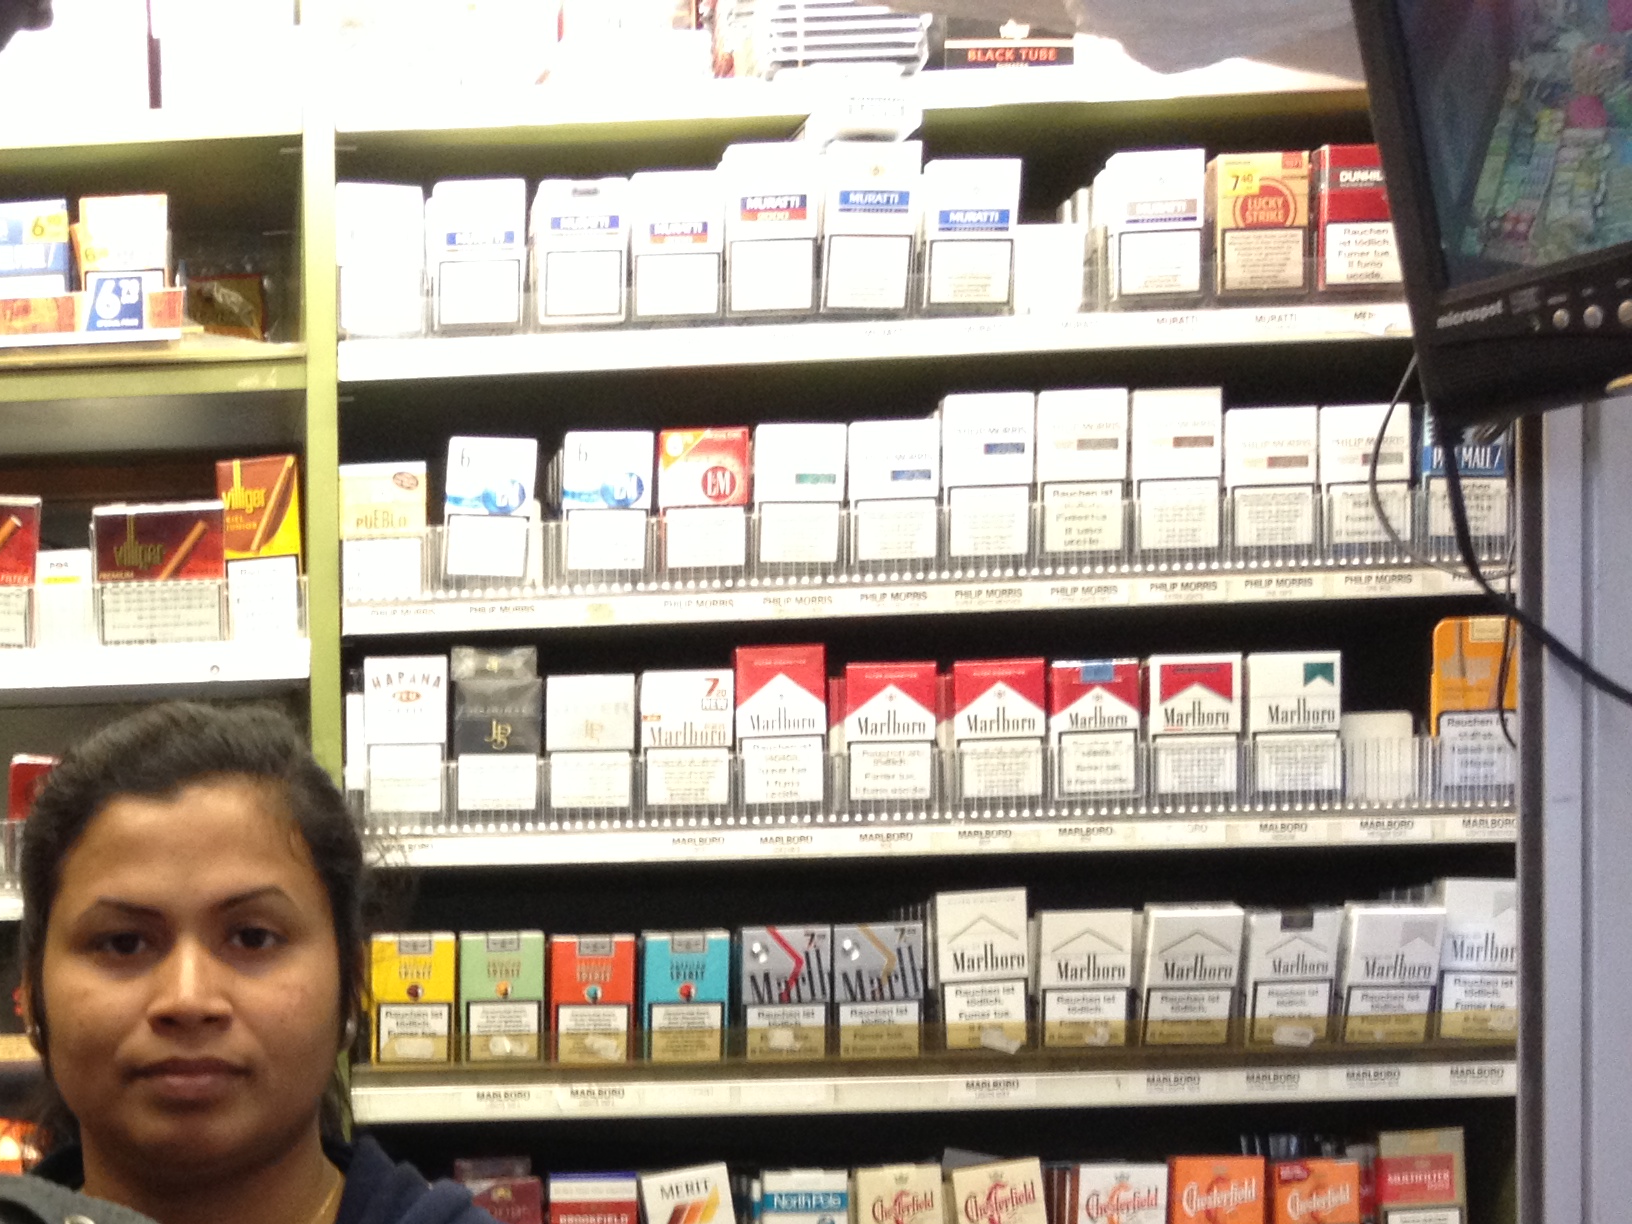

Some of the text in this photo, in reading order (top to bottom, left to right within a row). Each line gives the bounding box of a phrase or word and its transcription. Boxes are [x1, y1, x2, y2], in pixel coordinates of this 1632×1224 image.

[968, 47, 1058, 62] BLACK TUBE
[949, 211, 999, 225] MURATTI
[1243, 209, 1285, 227] STRIKE
[1246, 196, 1283, 213] LUCKY
[221, 474, 267, 515] villiger
[749, 704, 817, 732] Marlboro
[856, 706, 927, 735] Marlboro
[966, 704, 1037, 735] Marlboro
[1068, 699, 1129, 729] Marlboro
[1163, 698, 1231, 728] Marlboro
[1268, 696, 1336, 725] Marlboro
[649, 721, 727, 746] Marlboro
[952, 942, 1027, 973] Marlboro
[1056, 952, 1126, 982] Marlboro
[1163, 952, 1233, 983] Marlboro
[1271, 952, 1329, 976] Marlboro
[1364, 953, 1432, 981] Marlboro
[659, 1177, 711, 1200] MERIT
[1182, 1177, 1257, 1219] Chesterfield
[1286, 1182, 1351, 1221] Chesterfield
[1085, 1185, 1159, 1224] Chesterfield
